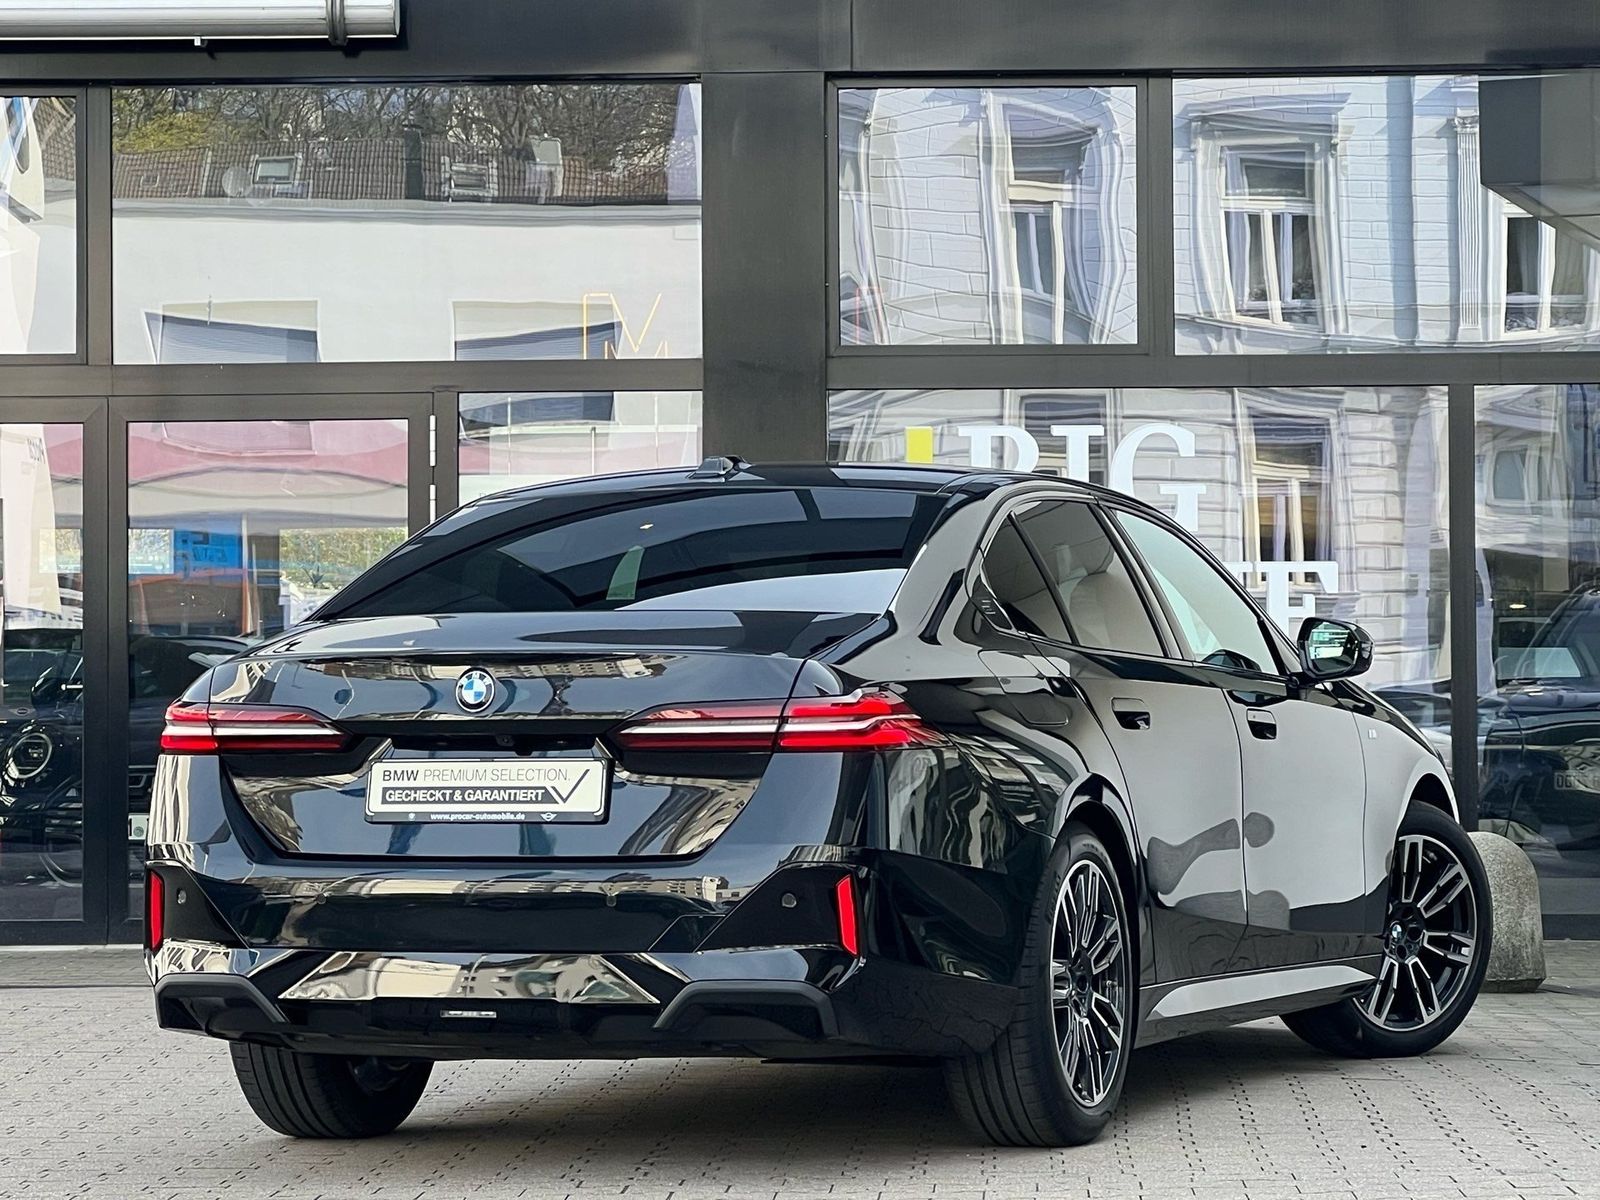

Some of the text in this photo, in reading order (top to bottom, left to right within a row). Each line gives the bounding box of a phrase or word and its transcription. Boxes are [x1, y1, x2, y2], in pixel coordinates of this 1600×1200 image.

[382, 768, 571, 781] BMW PREMIUM SELECTION.
[385, 789, 545, 802] GECHECKT & GARANTIERT
